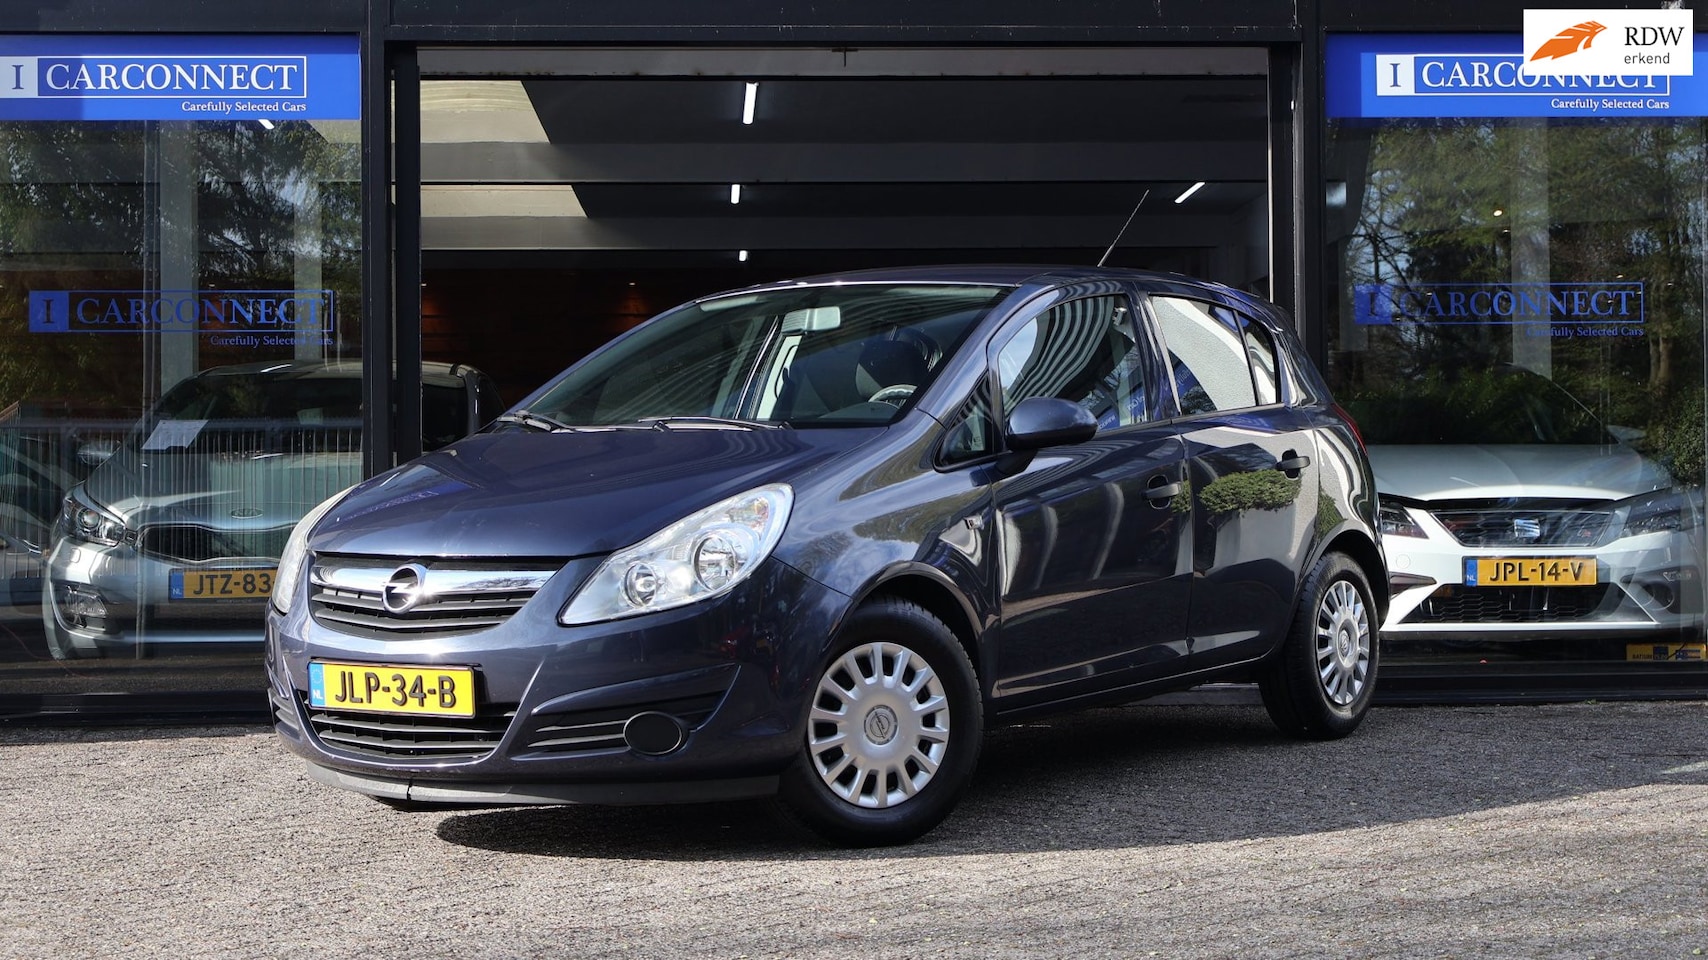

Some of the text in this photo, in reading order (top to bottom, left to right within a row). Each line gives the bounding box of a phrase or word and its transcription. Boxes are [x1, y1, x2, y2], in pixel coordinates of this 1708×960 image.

[46, 63, 298, 91] CARCONNECT
[181, 101, 307, 115] Carefully Selected Cars
[1551, 98, 1670, 112] Carefully Selected Cars
[76, 297, 325, 325] CARCONNECT
[1401, 289, 1635, 317] CARCONNECT
[210, 335, 260, 349] Carefully
[262, 335, 306, 346] Selected
[1526, 326, 1644, 340] Carefully Selected Cars
[1489, 562, 1585, 583] JPL-14-V
[193, 573, 275, 595] JTZ-83
[313, 689, 324, 700] NL
[335, 670, 457, 709] JLP-34-B
